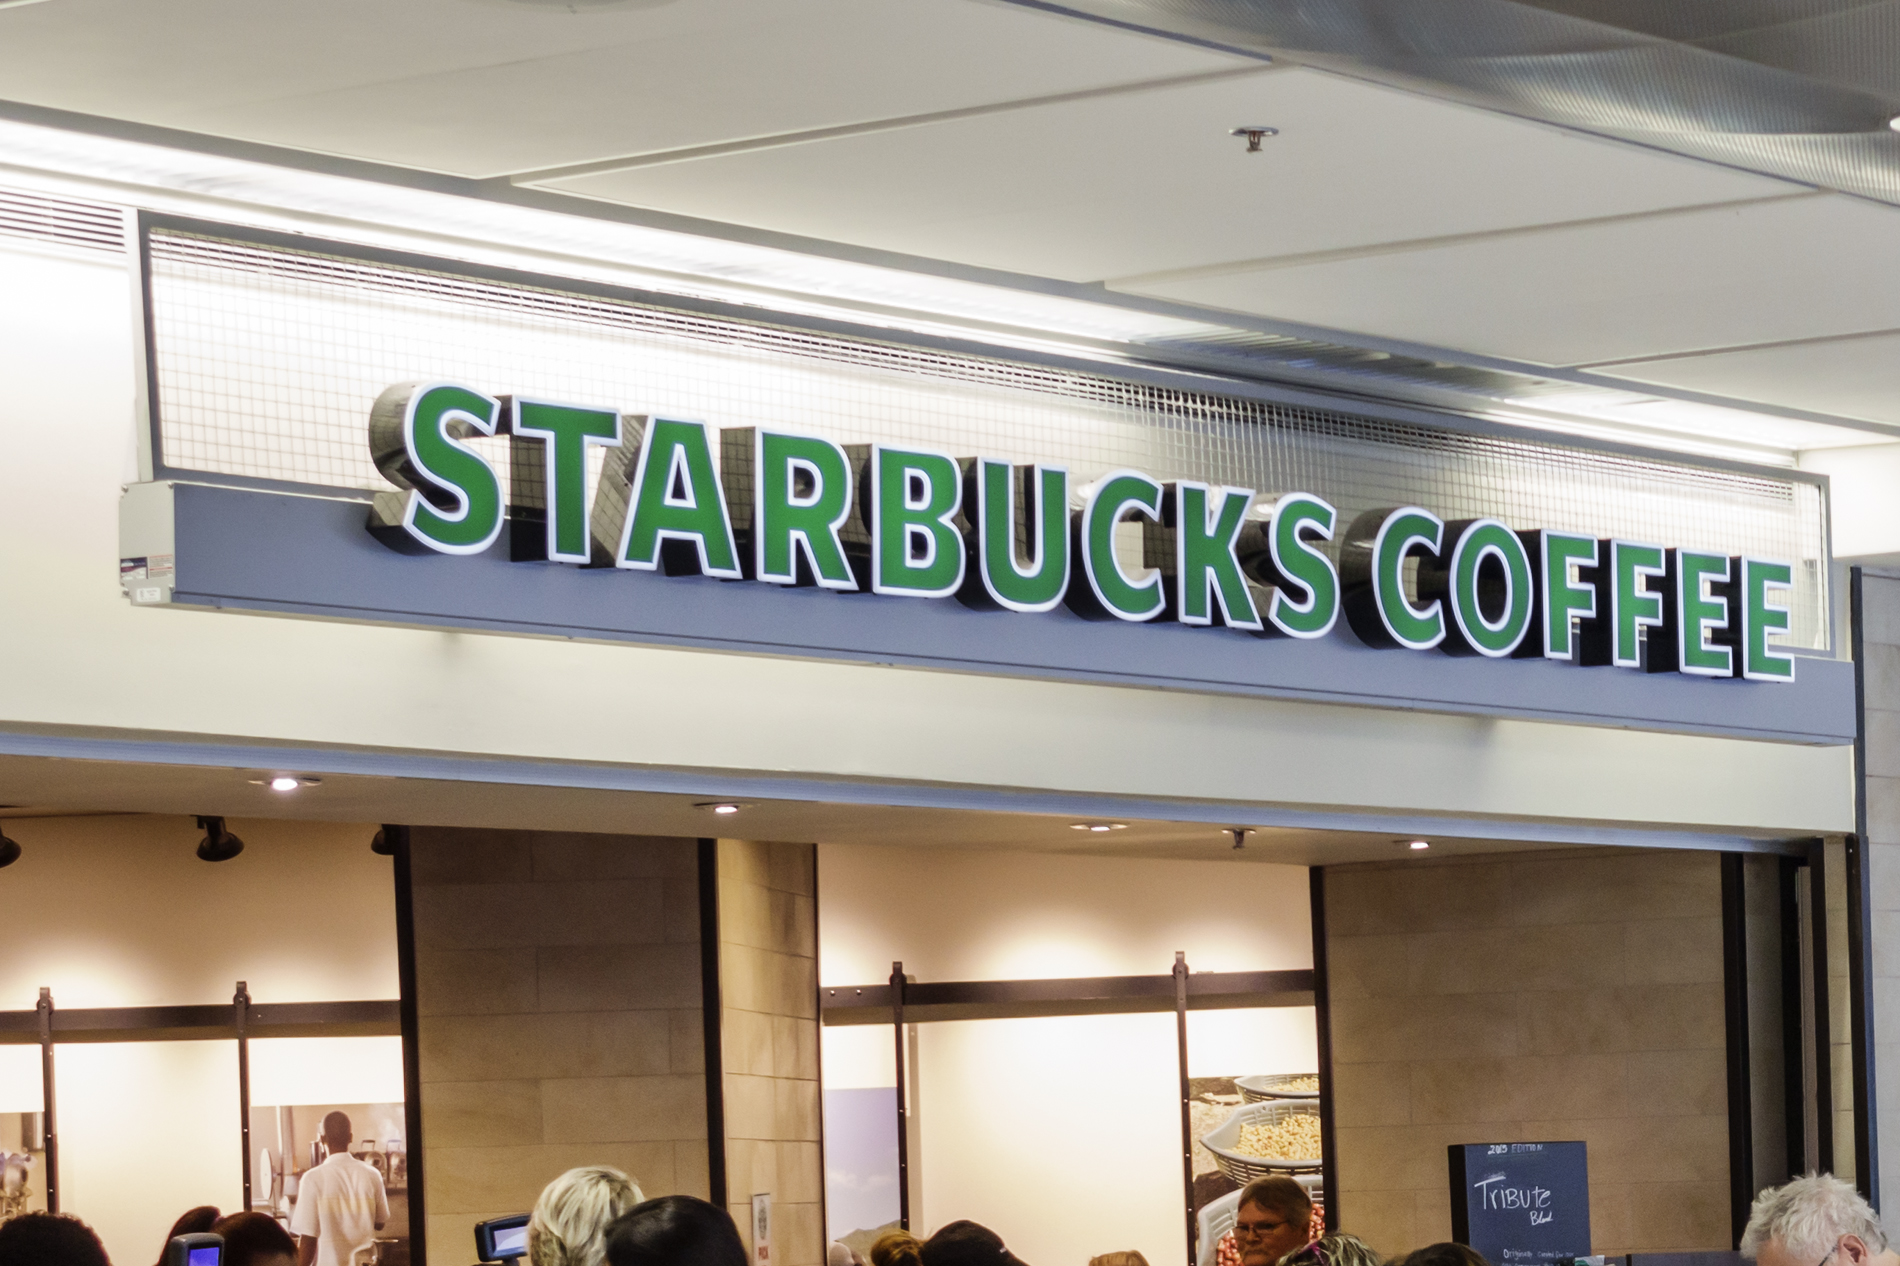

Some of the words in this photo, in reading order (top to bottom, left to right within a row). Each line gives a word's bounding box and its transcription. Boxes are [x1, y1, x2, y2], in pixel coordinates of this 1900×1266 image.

[401, 380, 1341, 640] STARBUCKS
[1371, 505, 1796, 683] COFFEE
[1487, 1143, 1509, 1155] 2015
[1511, 1143, 1544, 1154] EDITION
